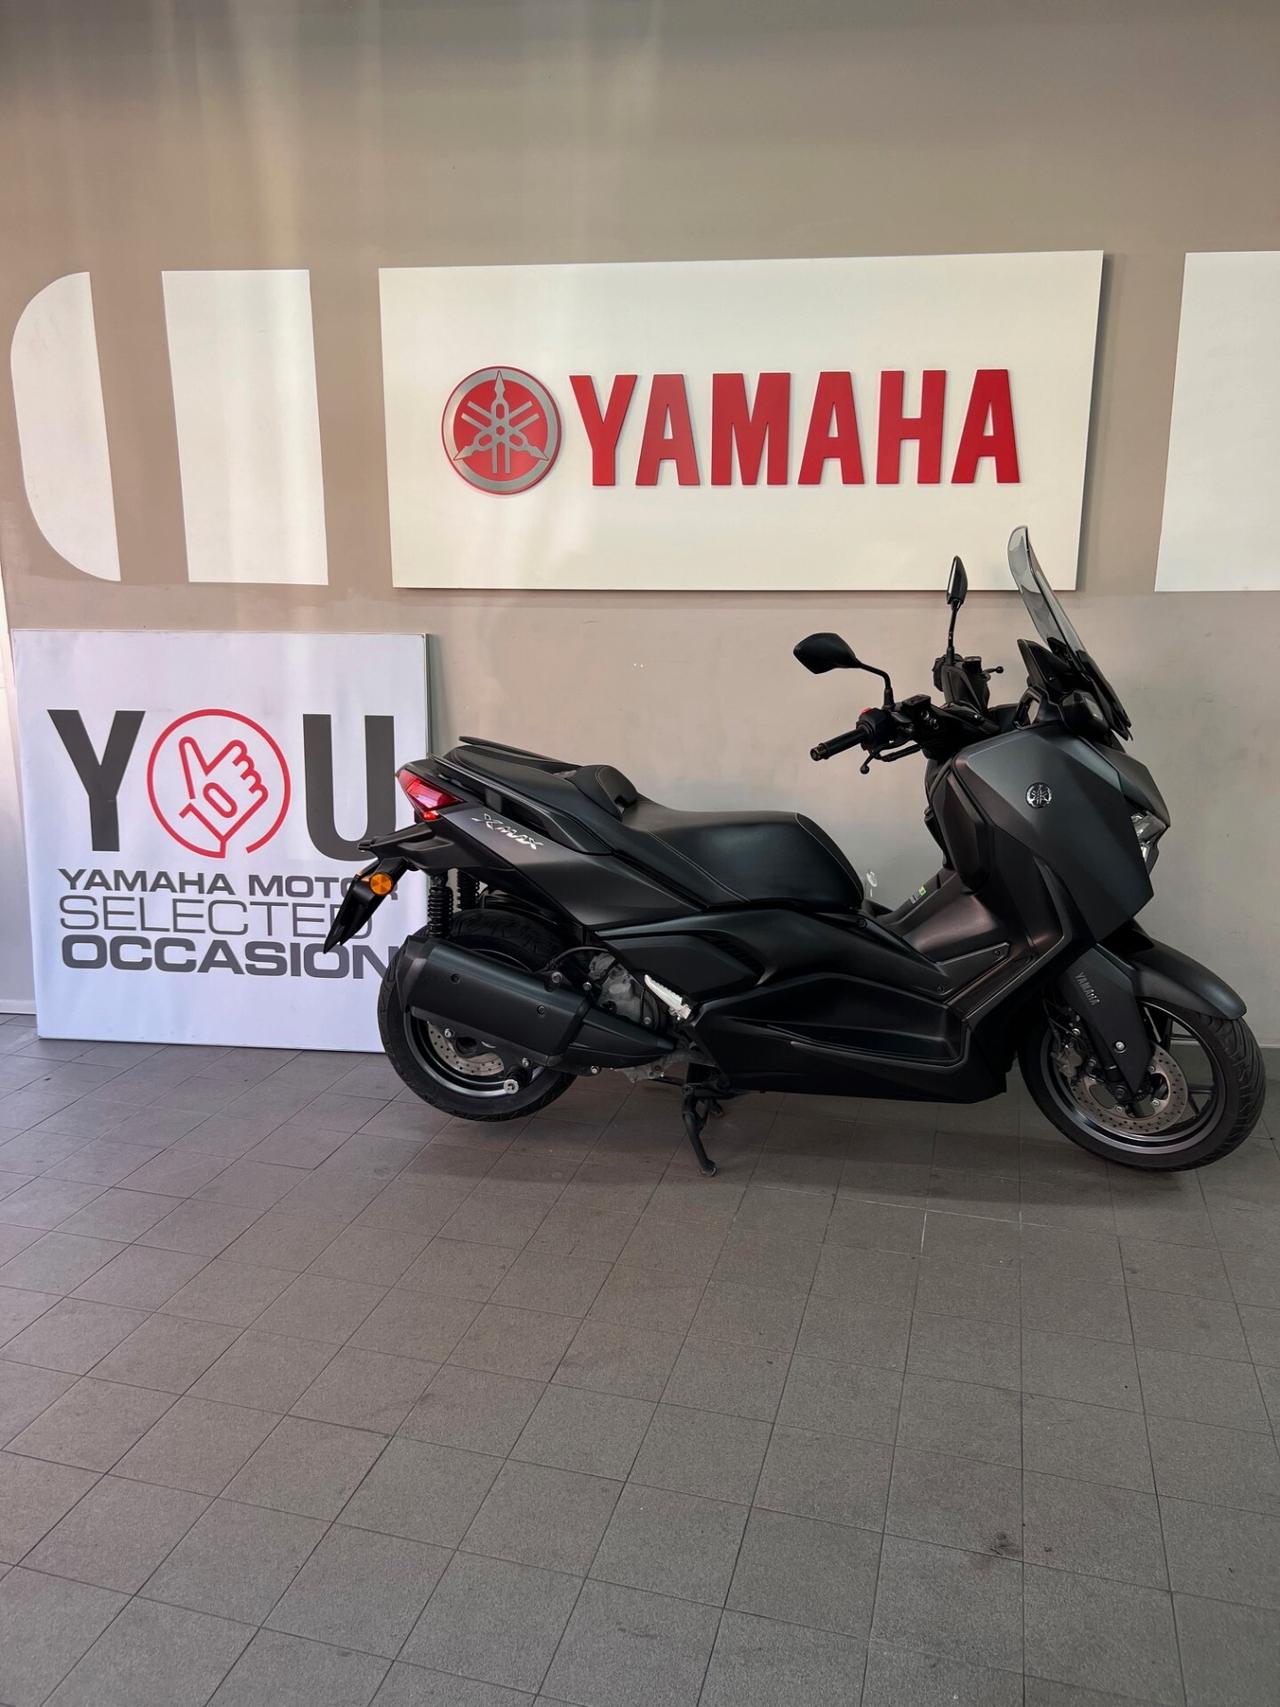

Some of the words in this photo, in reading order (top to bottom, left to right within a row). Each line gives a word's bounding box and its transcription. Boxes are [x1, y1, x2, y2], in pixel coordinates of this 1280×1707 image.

[570, 369, 1020, 487] YAMAHA
[58, 868, 236, 896] YAMAHA
[1075, 971, 1100, 1006] YAMAHA
